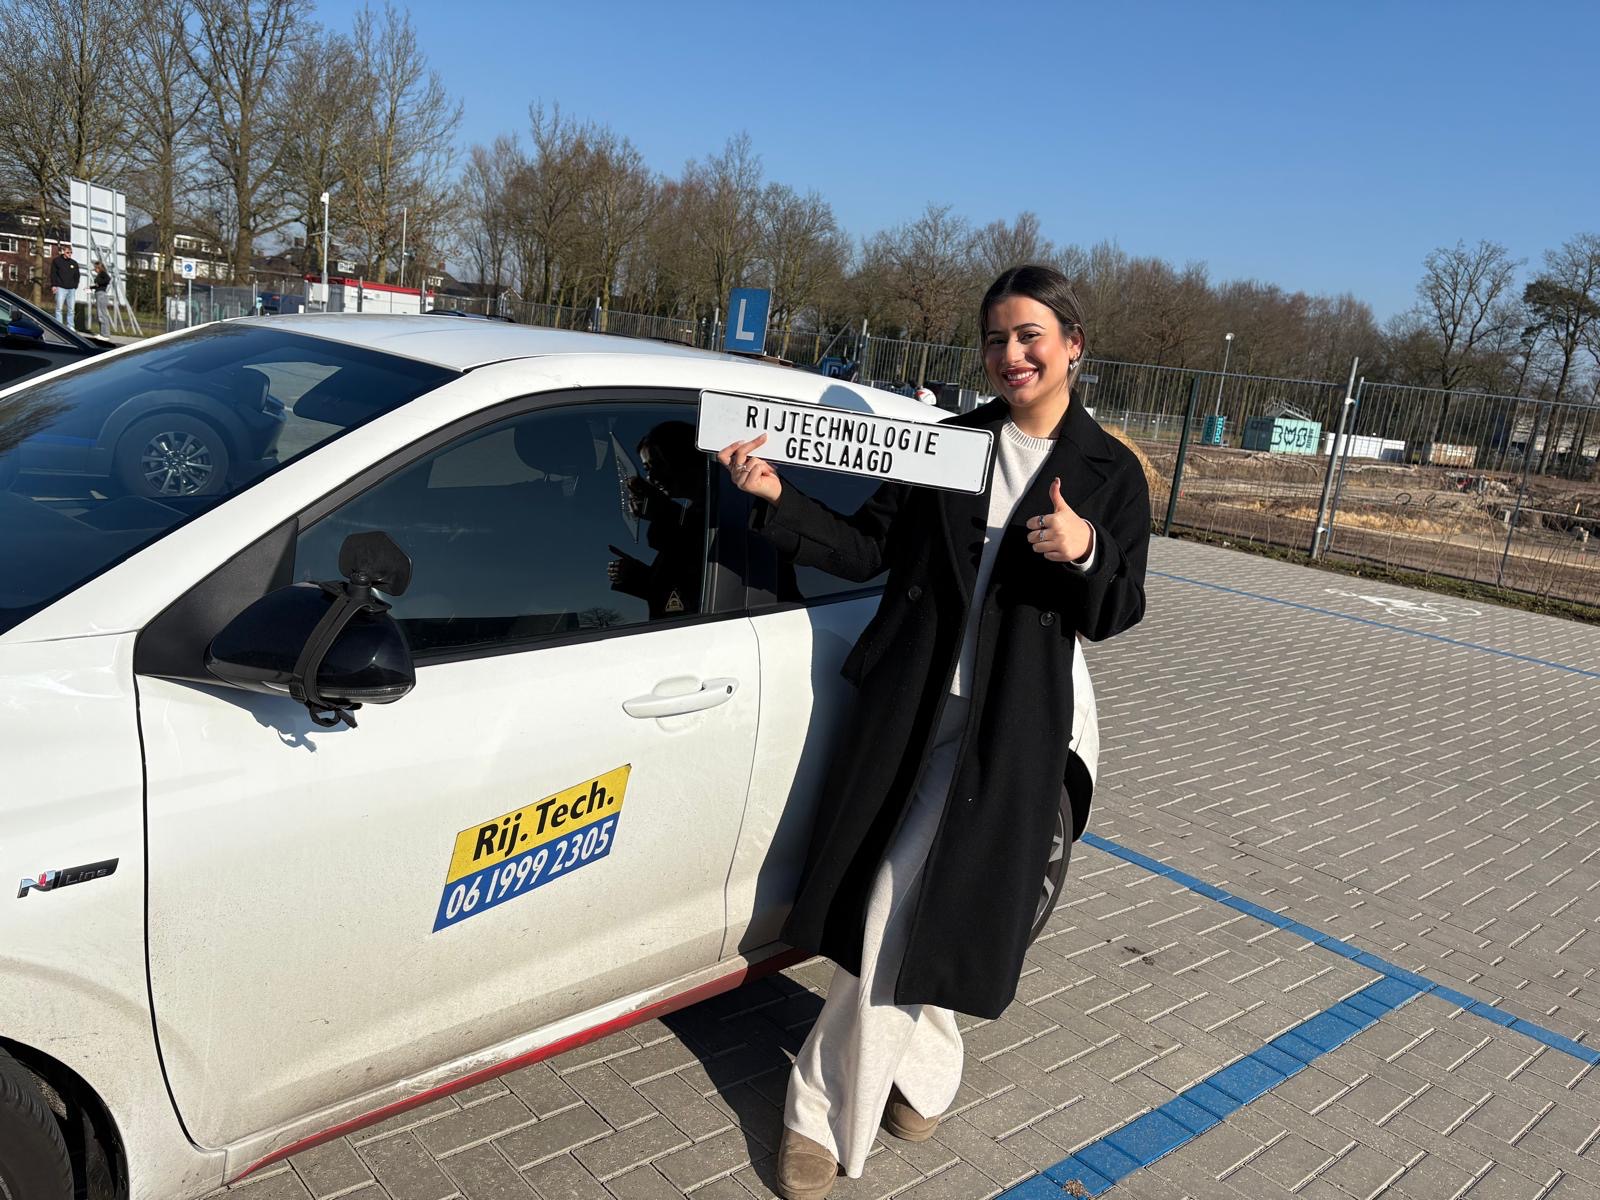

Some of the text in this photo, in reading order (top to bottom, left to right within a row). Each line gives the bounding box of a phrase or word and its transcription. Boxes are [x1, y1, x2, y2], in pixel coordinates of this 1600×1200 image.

[735, 298, 755, 341] L
[746, 405, 940, 455] RIJTECHNOLOGIE
[786, 437, 893, 474] GESLAAGD
[65, 868, 108, 885] Line
[446, 819, 614, 920] 06 1999 2305
